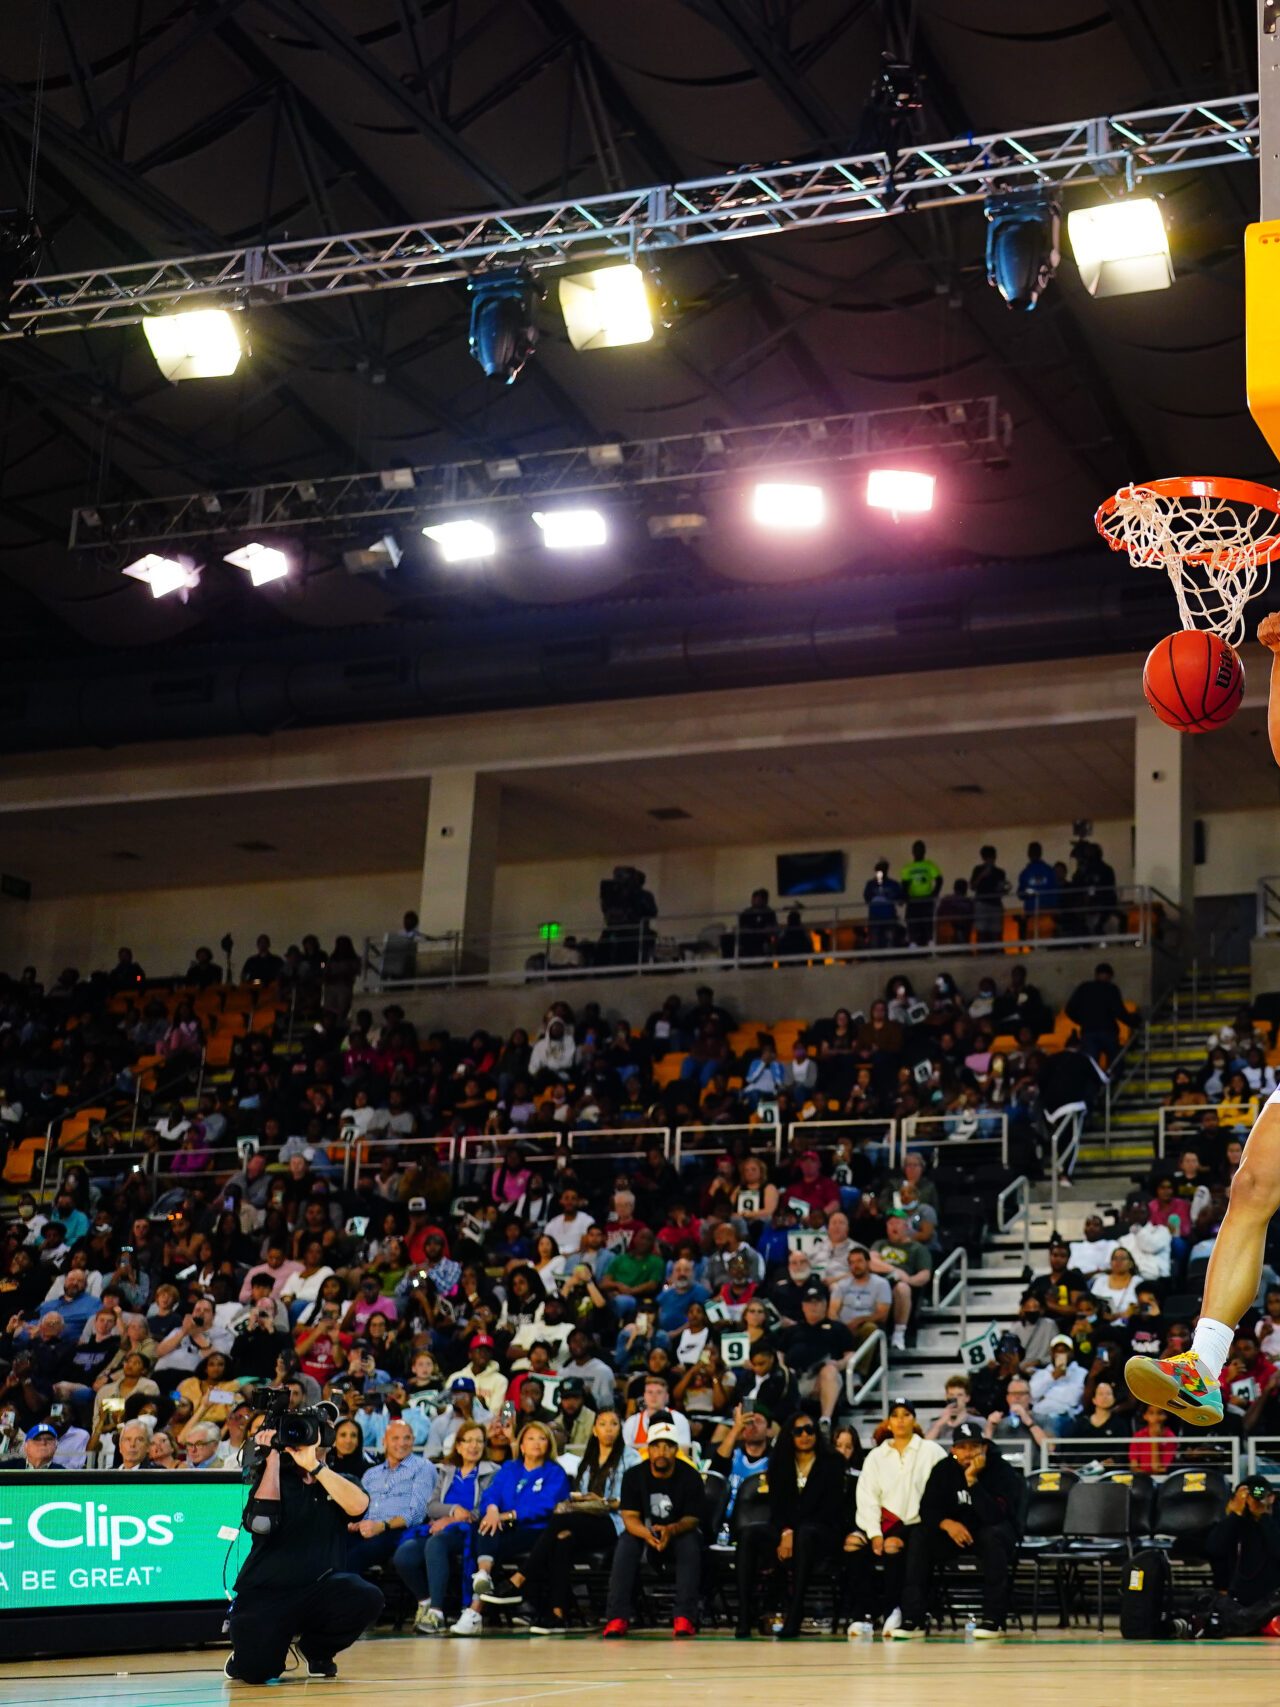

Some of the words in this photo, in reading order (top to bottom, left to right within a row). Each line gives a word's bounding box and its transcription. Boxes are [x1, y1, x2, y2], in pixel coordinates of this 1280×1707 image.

[727, 1341, 744, 1361] 9
[969, 1344, 986, 1365] 8
[21, 1570, 57, 1591] BE
